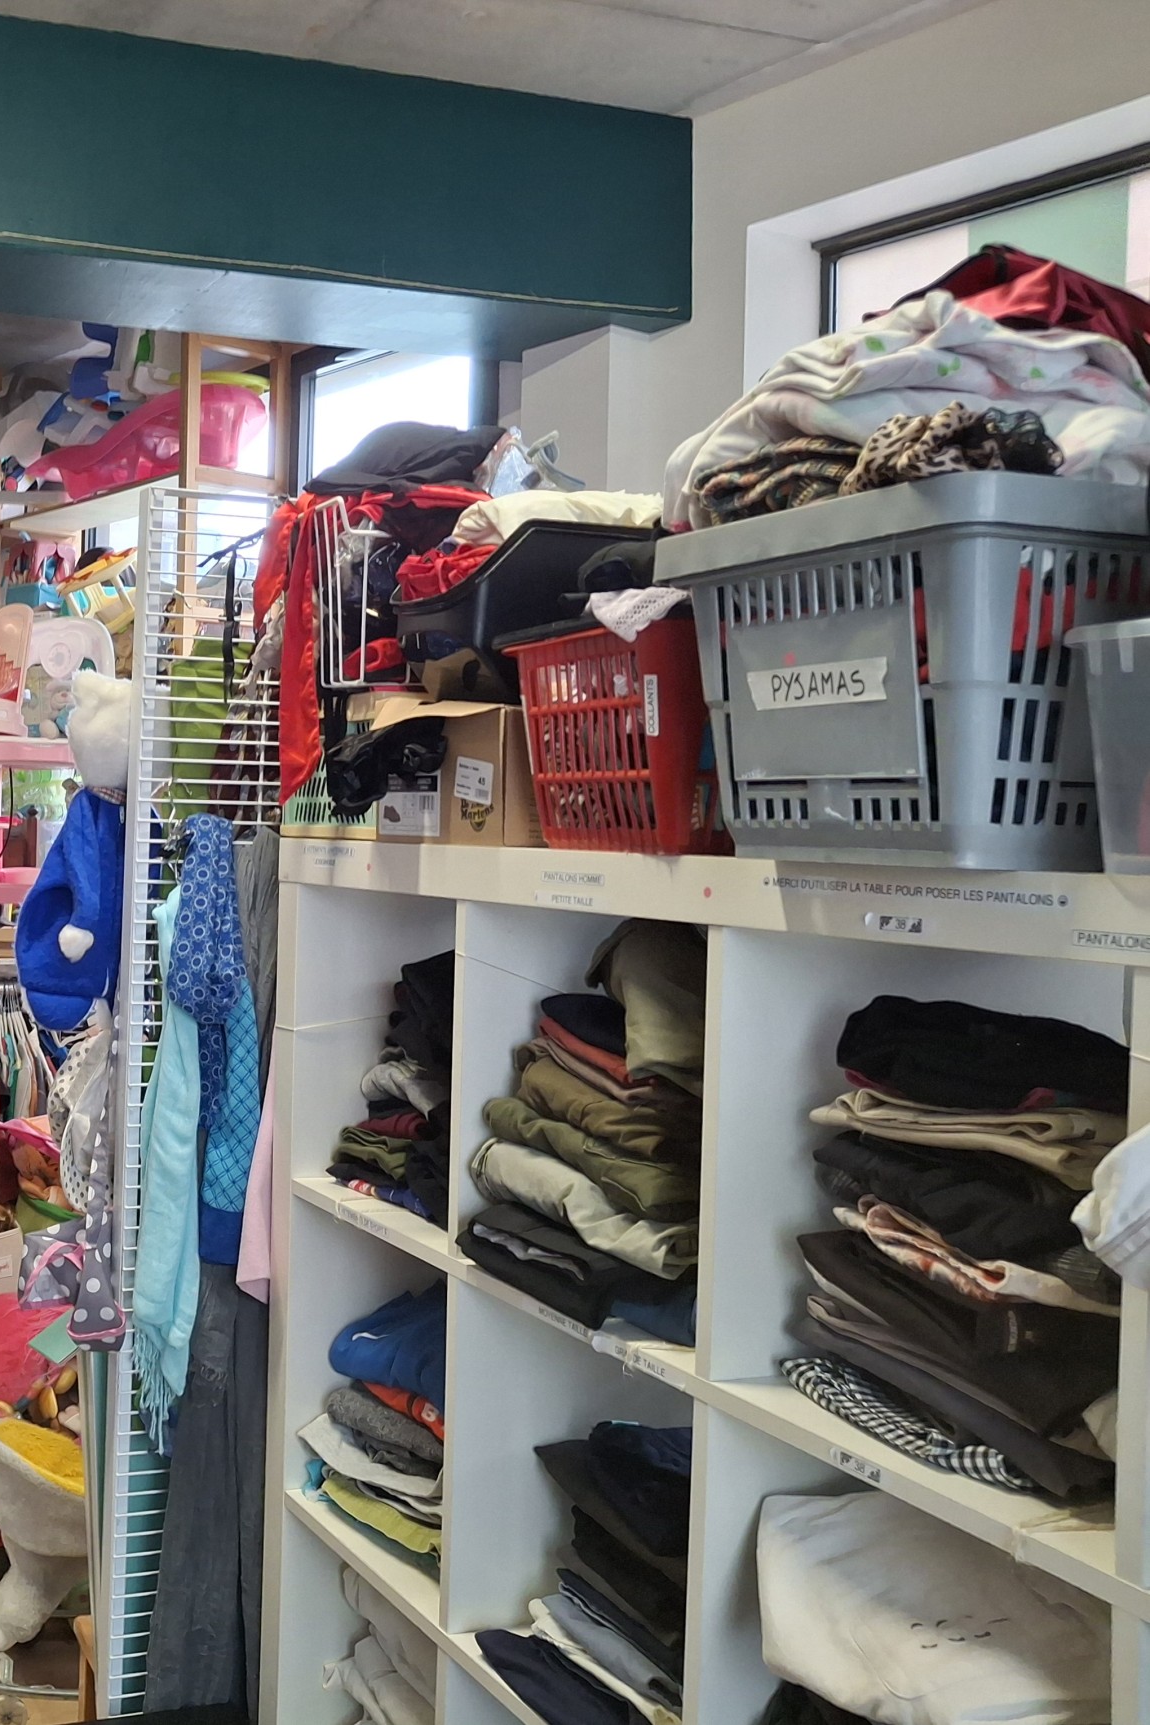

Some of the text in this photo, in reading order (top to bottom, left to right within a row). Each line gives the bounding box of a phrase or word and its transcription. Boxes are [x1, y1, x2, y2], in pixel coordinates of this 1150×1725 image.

[646, 678, 656, 734] COLLANTS
[543, 871, 602, 884] PANTALONS HOMME
[772, 877, 1054, 906] MERCI D'UTILISER LA TABLE POUR POSER LES PANTALONS
[551, 894, 594, 906] PETITE TAILLE
[895, 918, 907, 930] 38
[538, 1306, 588, 1338] MOYENNE TAILLE
[614, 1345, 666, 1377] GRADE TAILLE
